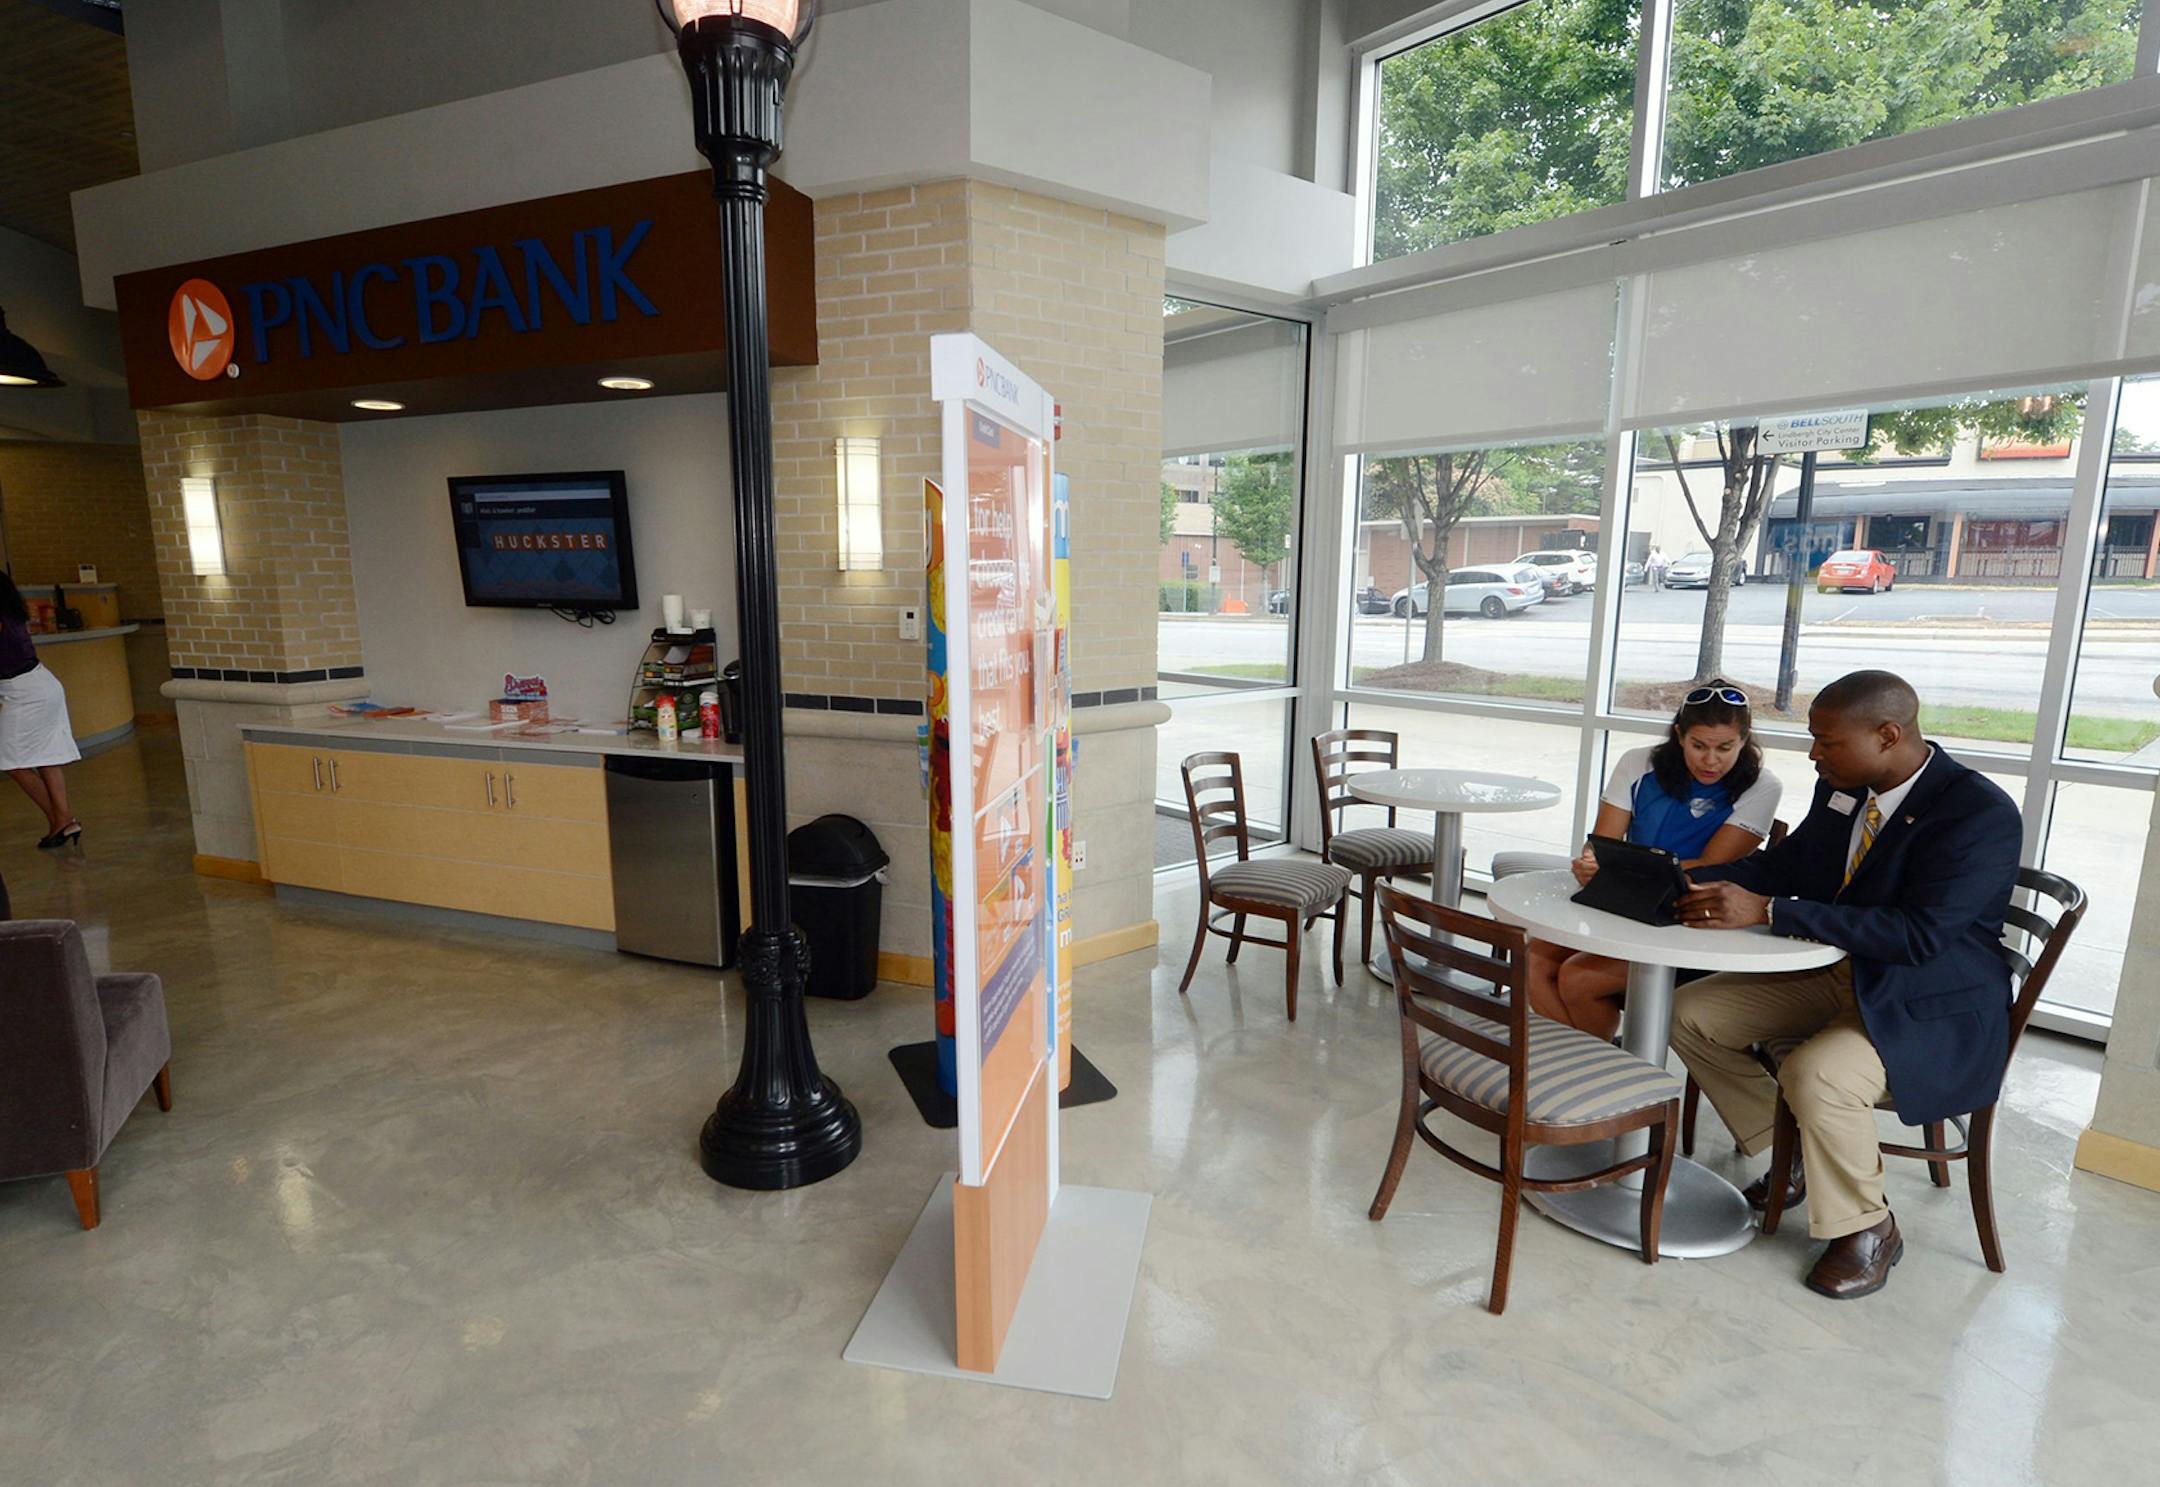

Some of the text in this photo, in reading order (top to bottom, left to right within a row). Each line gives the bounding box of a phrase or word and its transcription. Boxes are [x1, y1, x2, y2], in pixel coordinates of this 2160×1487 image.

[1790, 414, 1863, 428] BELLSOUTH
[1778, 426, 1860, 440] Lindbergh City Center
[1778, 435, 1860, 448] Visitor Parking
[991, 500, 1012, 542] help
[495, 534, 606, 549] HUCKSTER
[978, 652, 998, 690] that
